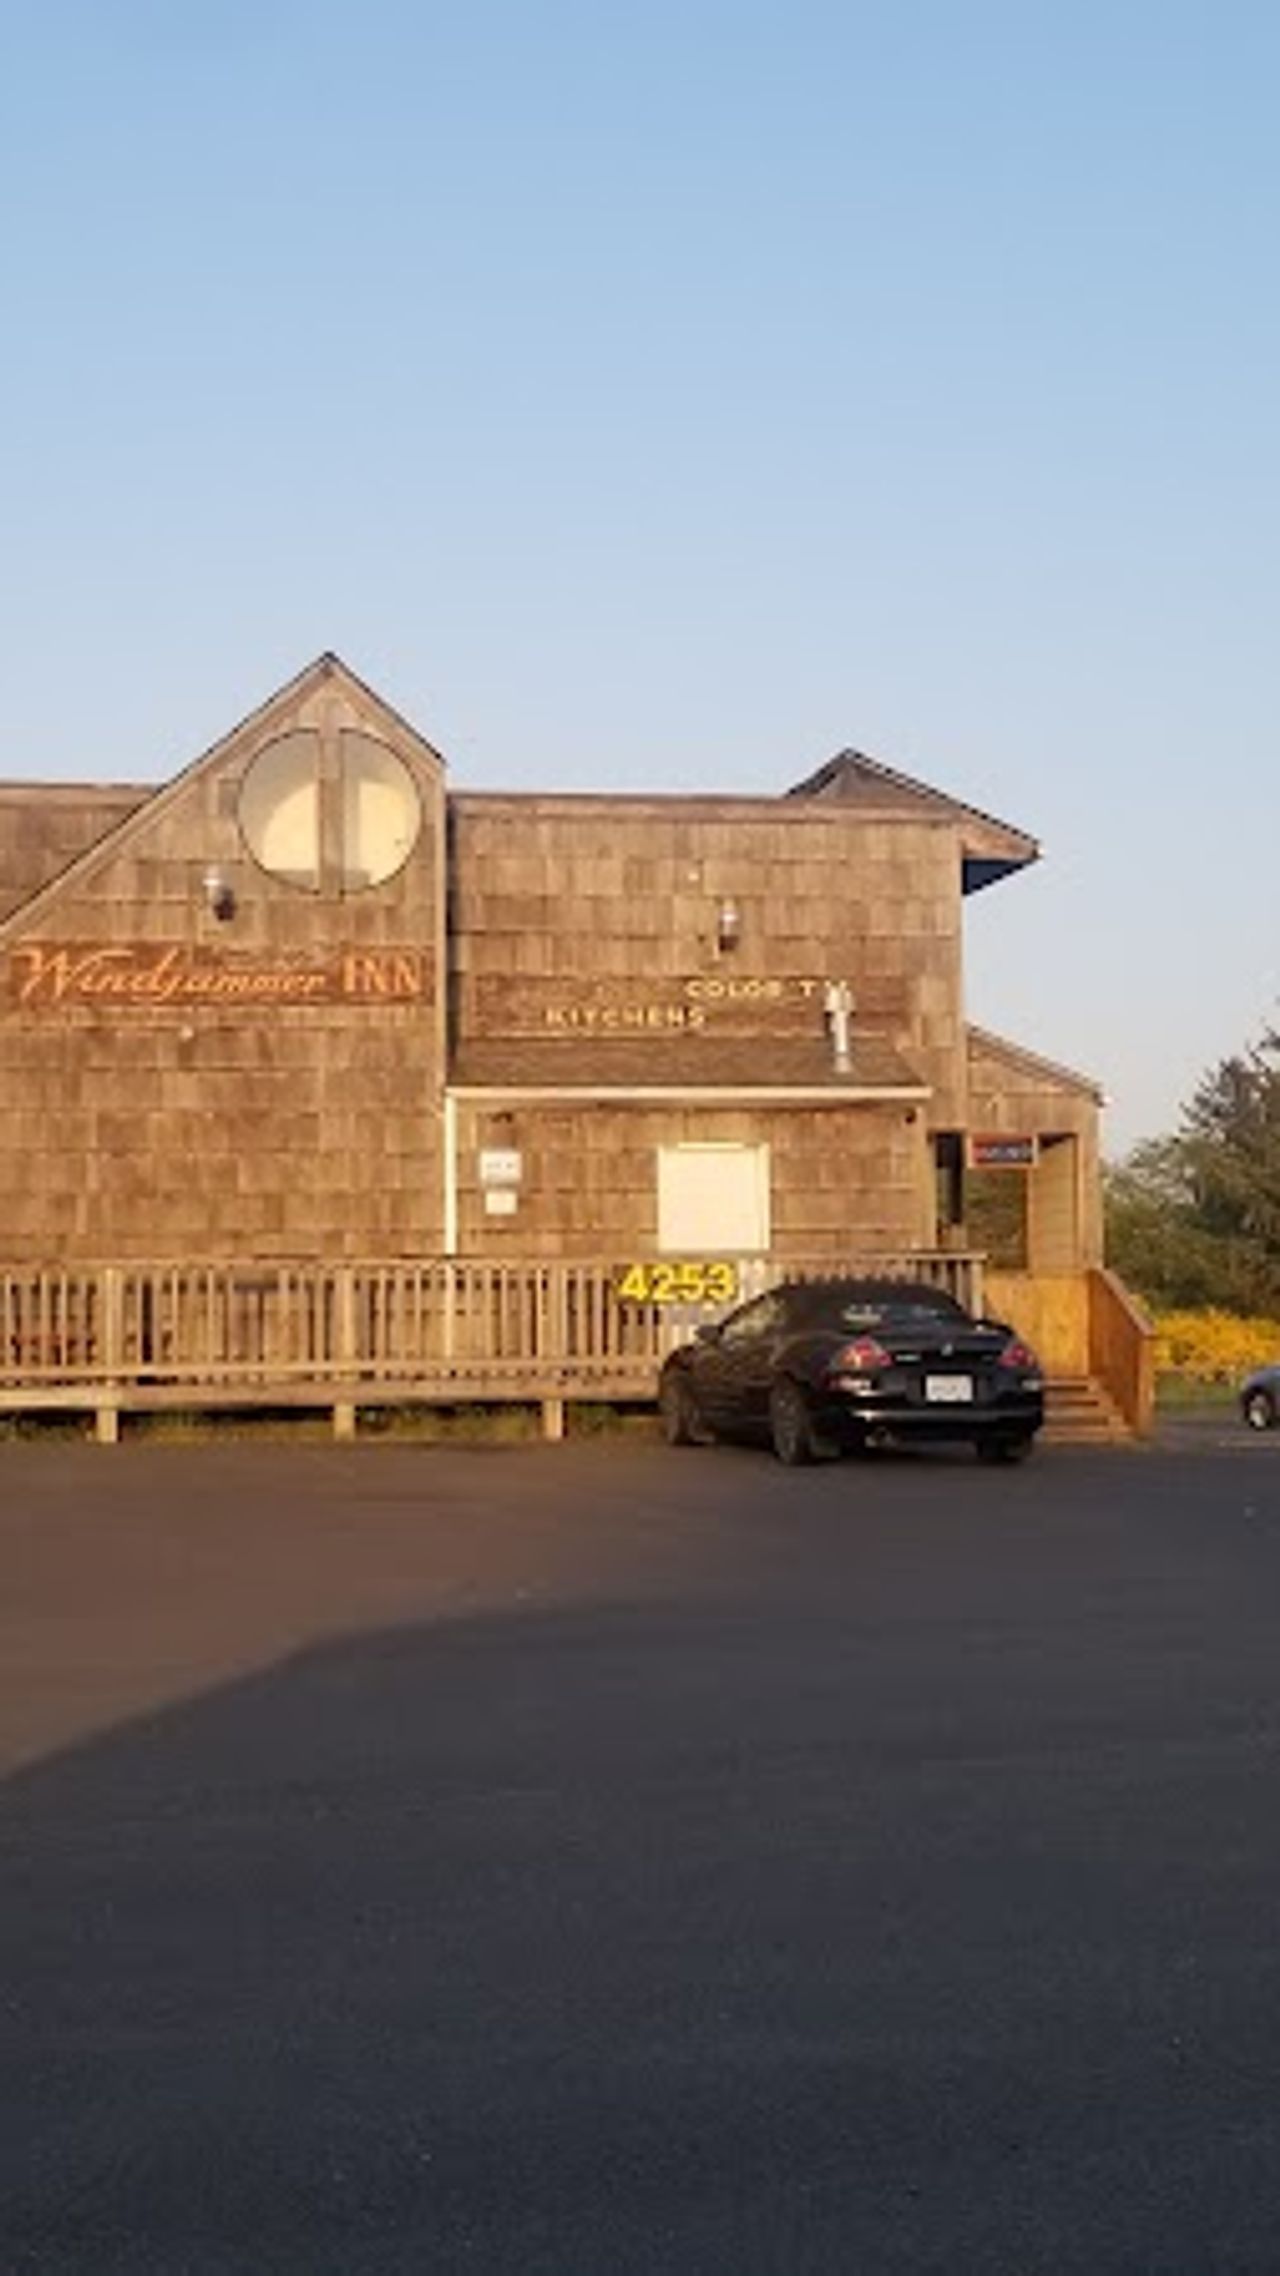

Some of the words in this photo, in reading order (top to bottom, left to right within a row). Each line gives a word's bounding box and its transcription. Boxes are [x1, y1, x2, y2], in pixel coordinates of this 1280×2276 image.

[11, 948, 327, 1000] Windjammer
[342, 952, 423, 993] INN
[685, 979, 783, 998] COLOR
[545, 1005, 706, 1028] KITCHENS
[619, 1263, 735, 1301] 4253
